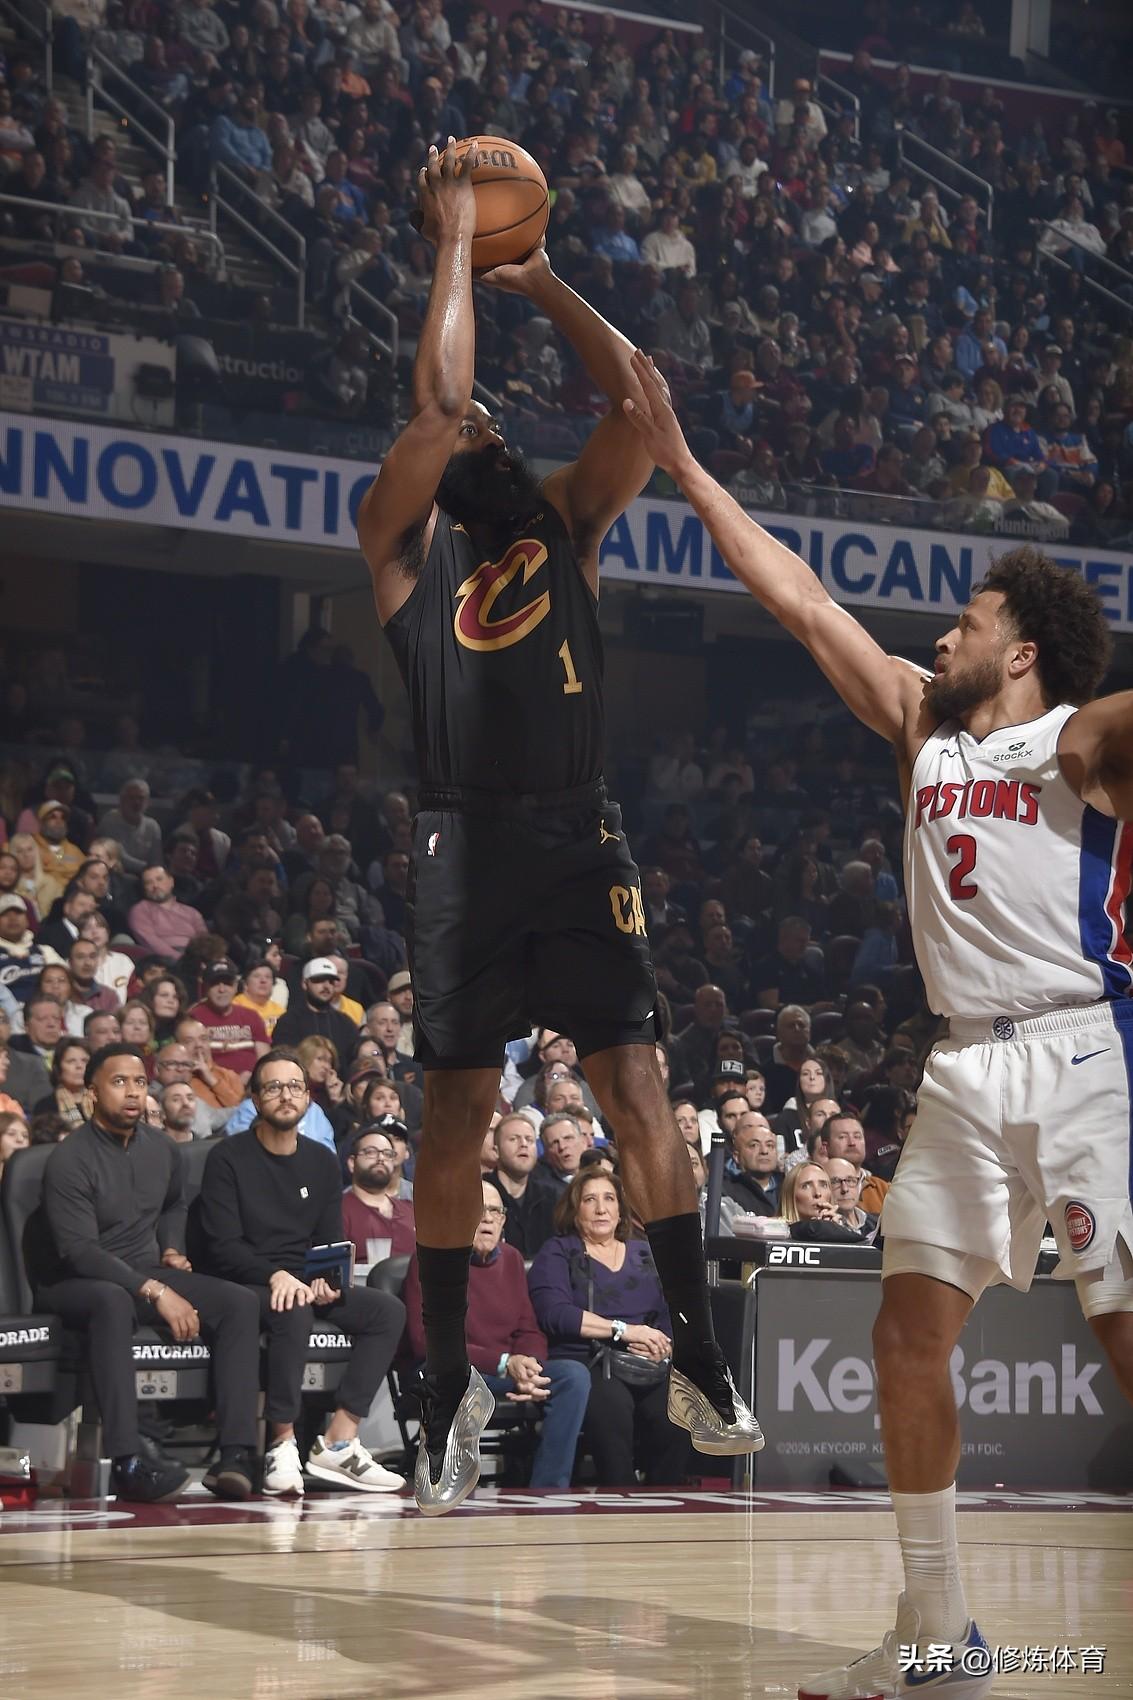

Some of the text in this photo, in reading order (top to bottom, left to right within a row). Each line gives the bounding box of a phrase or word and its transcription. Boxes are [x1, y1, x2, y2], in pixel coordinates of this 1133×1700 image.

[3, 344, 80, 385] WTAM
[600, 511, 973, 605] AMICAN
[559, 640, 582, 694] 1
[915, 779, 1041, 830] PISTONS
[947, 834, 977, 900] 2
[769, 1246, 820, 1265] anc
[0, 1327, 50, 1346] ORADE
[777, 1339, 1104, 1430] Keank
